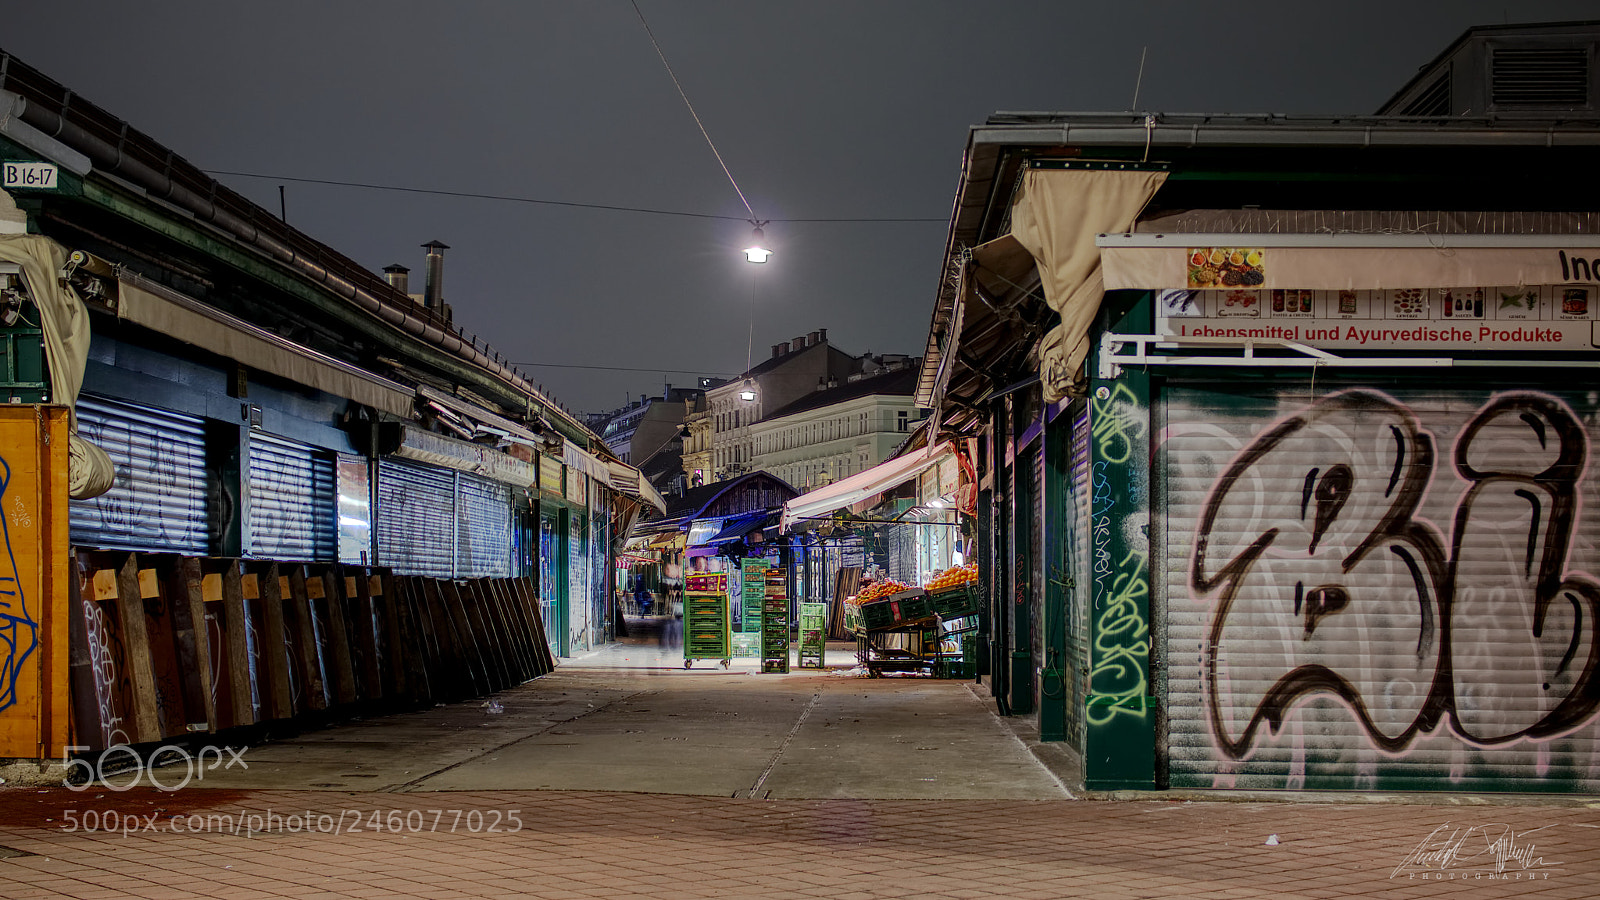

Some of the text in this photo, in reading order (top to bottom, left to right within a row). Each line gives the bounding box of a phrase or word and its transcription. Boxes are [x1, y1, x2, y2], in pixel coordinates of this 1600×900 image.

[7, 165, 53, 185] B 16-17
[1181, 325, 1563, 345] Lebensmittel und Ayurvedische Produkte
